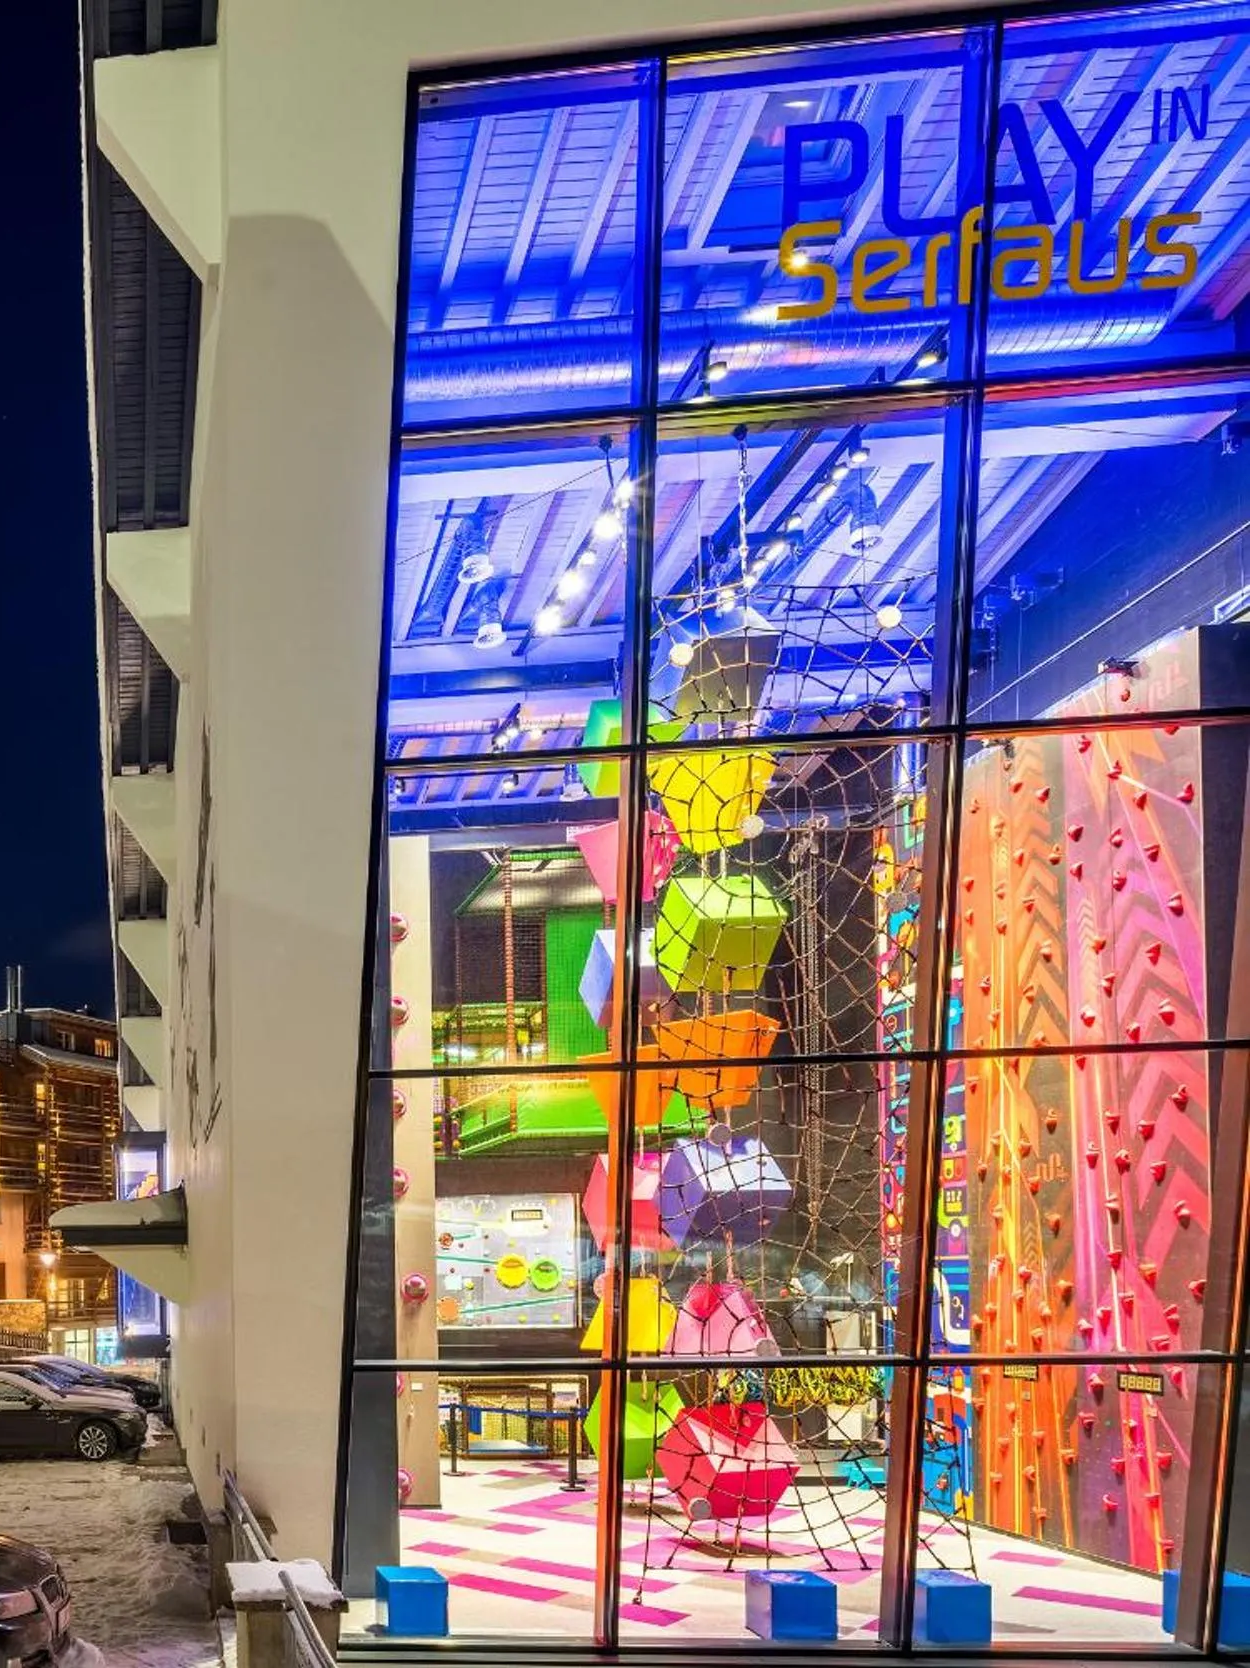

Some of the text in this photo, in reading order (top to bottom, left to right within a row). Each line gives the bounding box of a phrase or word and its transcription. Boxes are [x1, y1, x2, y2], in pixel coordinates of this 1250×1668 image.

[780, 84, 1211, 236] PLAY IN
[776, 205, 1202, 320] Serfaus
